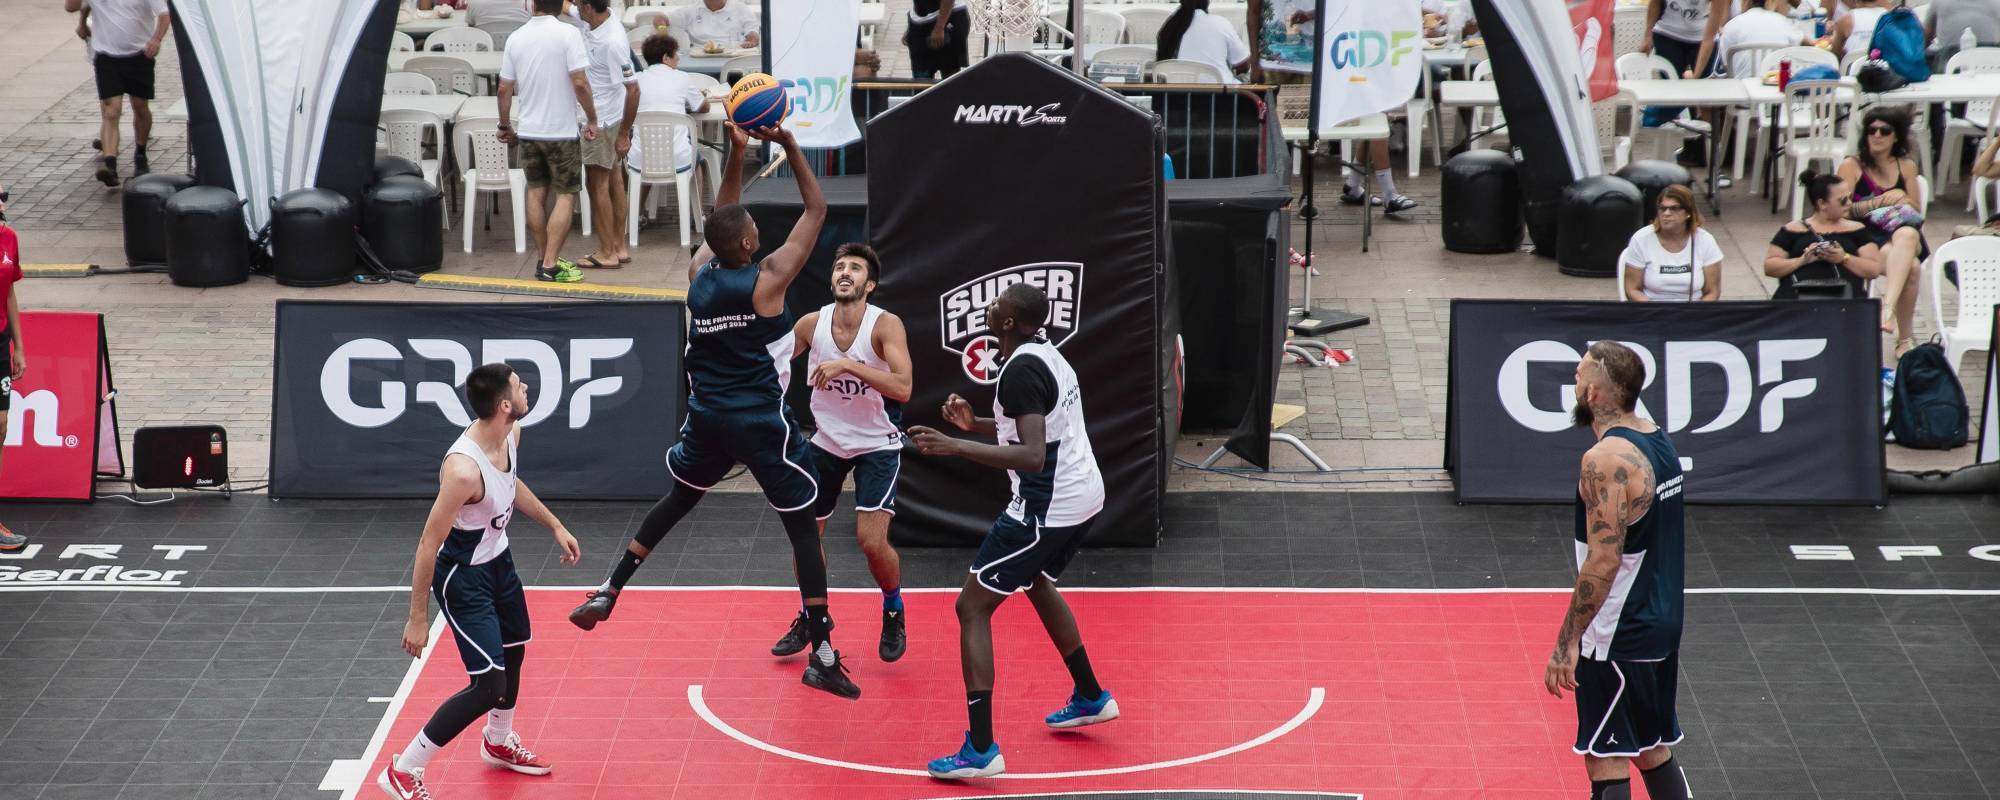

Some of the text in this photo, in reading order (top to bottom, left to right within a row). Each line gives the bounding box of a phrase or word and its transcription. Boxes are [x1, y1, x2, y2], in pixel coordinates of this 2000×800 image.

[953, 104, 1033, 123] MARTY
[946, 269, 1074, 320] SUPER
[712, 314, 741, 324] FRANCE
[949, 301, 1073, 342] LEE
[320, 338, 634, 429] GRDF
